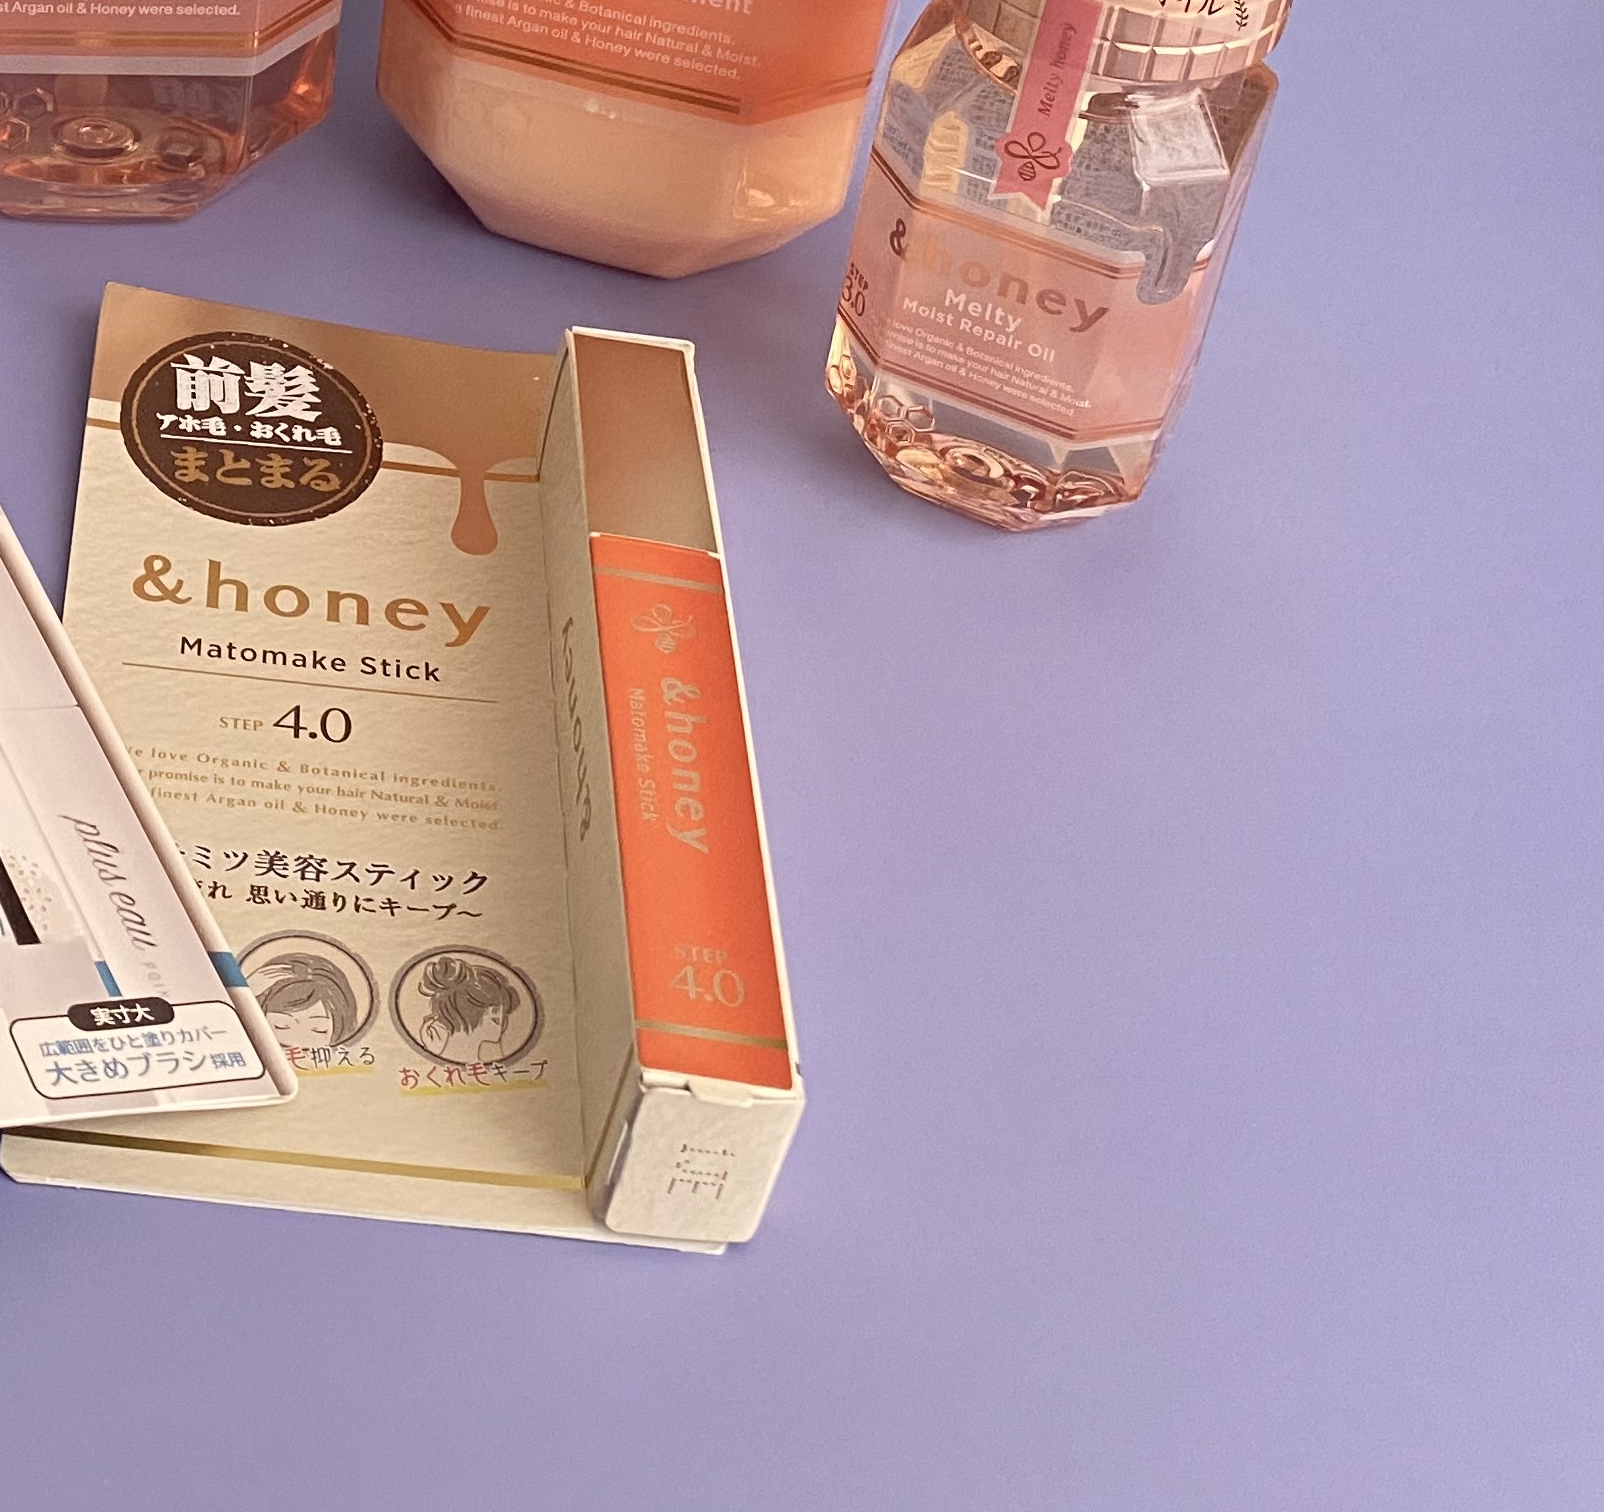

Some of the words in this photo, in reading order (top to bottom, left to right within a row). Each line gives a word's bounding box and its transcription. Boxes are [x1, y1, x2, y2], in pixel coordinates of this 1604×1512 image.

[11, 0, 54, 16] Argan
[56, 2, 74, 15] oil
[90, 4, 136, 18] Honey
[138, 4, 173, 16] were
[176, 4, 241, 17] selected.
[466, 4, 505, 25] finest
[507, 15, 548, 34] Argan
[585, 35, 632, 58] Honey
[523, 3, 537, 16] to
[539, 8, 578, 26] make
[581, 18, 613, 35] your
[614, 25, 643, 41] hair
[645, 31, 698, 54] Natural
[579, 0, 647, 27] Botanical
[649, 15, 735, 46] ingredients.
[889, 218, 1110, 334] &honey
[903, 297, 955, 327] Moist
[959, 317, 1023, 350] Repair
[1027, 343, 1056, 364] Oil
[944, 288, 1023, 332] Melty
[171, 353, 323, 423] 前髪
[155, 411, 344, 448] アホ毛・おくれ毛
[169, 445, 341, 492] まとまる
[131, 553, 492, 648] &honey
[179, 636, 348, 673] Matomake
[359, 655, 443, 682] Stick
[219, 715, 264, 733] STEP
[272, 704, 353, 745] 4.0
[628, 688, 650, 773] Matomake
[151, 747, 188, 761] love
[197, 752, 270, 769] Organic
[277, 760, 291, 774] &
[300, 763, 385, 782] Botanical
[661, 677, 711, 855] &honey
[148, 768, 209, 784] promise
[213, 773, 225, 785] is
[231, 776, 246, 787] to
[251, 779, 292, 792] make
[297, 784, 332, 798] your
[336, 785, 366, 799] hair
[370, 789, 430, 805] Natural
[434, 795, 449, 808] &
[151, 787, 198, 802] finest
[206, 793, 257, 808] Argan
[263, 799, 285, 811] oil
[292, 800, 307, 814] &
[315, 803, 369, 821] Honey
[376, 811, 419, 824] were
[638, 777, 660, 823] Stick
[108, 890, 159, 949] eau
[673, 943, 730, 965] STEP
[668, 966, 747, 1009] 4.0
[89, 1004, 156, 1029] 実寸大
[39, 1025, 228, 1057] 広範囲をひと塗りカバー
[46, 1049, 247, 1087] 大きめブラシ採用
[399, 1059, 550, 1090] おくれ毛キープ
